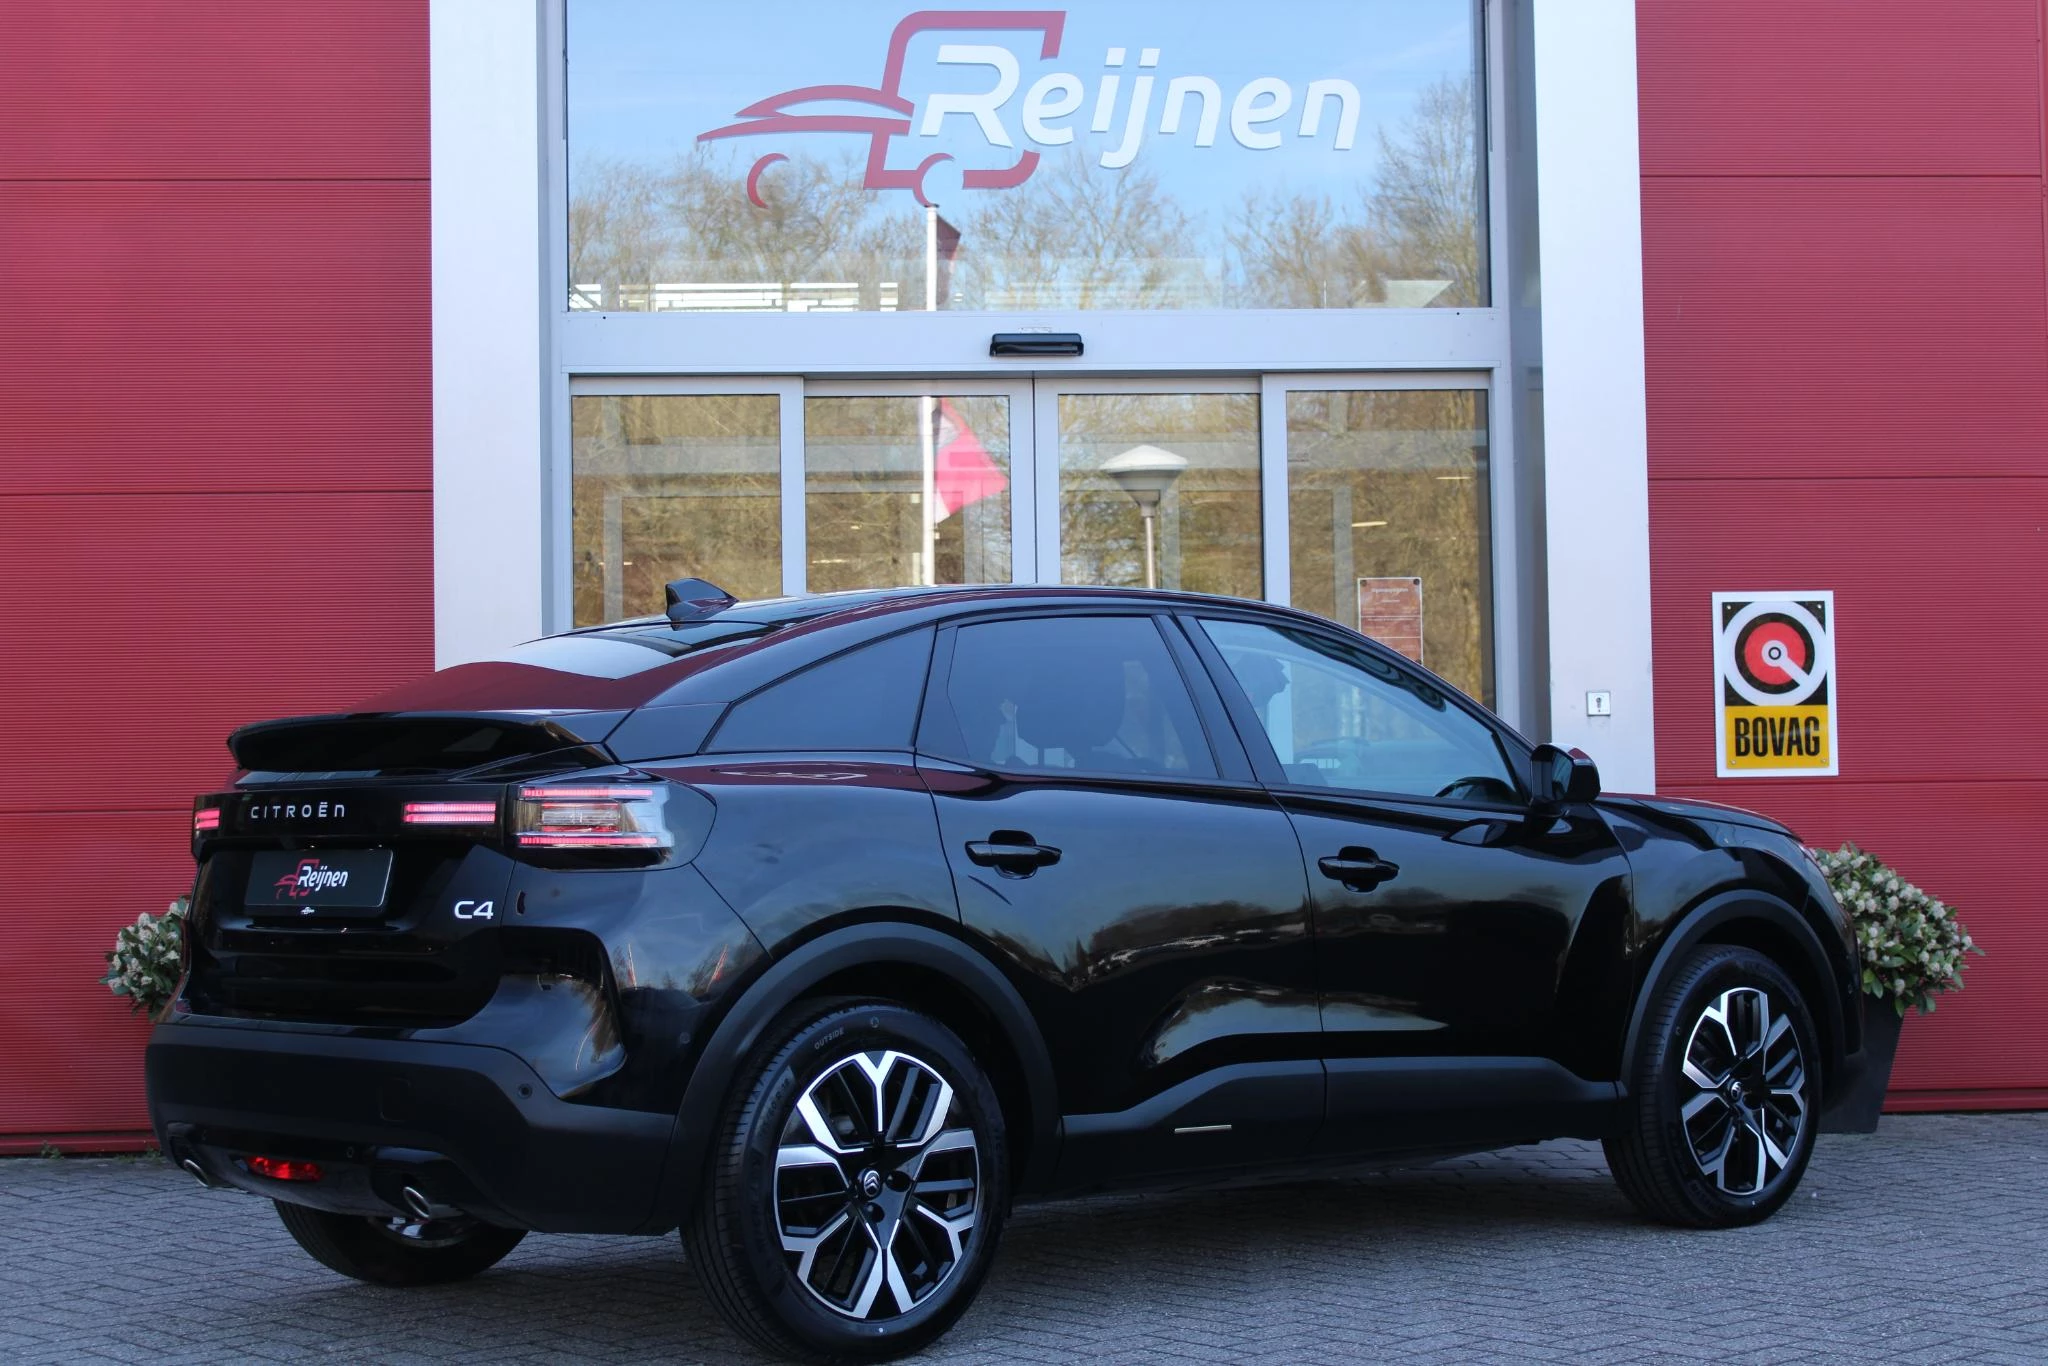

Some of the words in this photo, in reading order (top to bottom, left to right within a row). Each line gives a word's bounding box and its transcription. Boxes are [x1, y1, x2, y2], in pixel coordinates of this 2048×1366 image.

[919, 44, 1362, 169] Reijnen
[1734, 716, 1821, 757] BOVAG
[297, 865, 348, 892] Reijnen
[454, 900, 494, 920] C4
[814, 1026, 845, 1050] OUTSIDE
